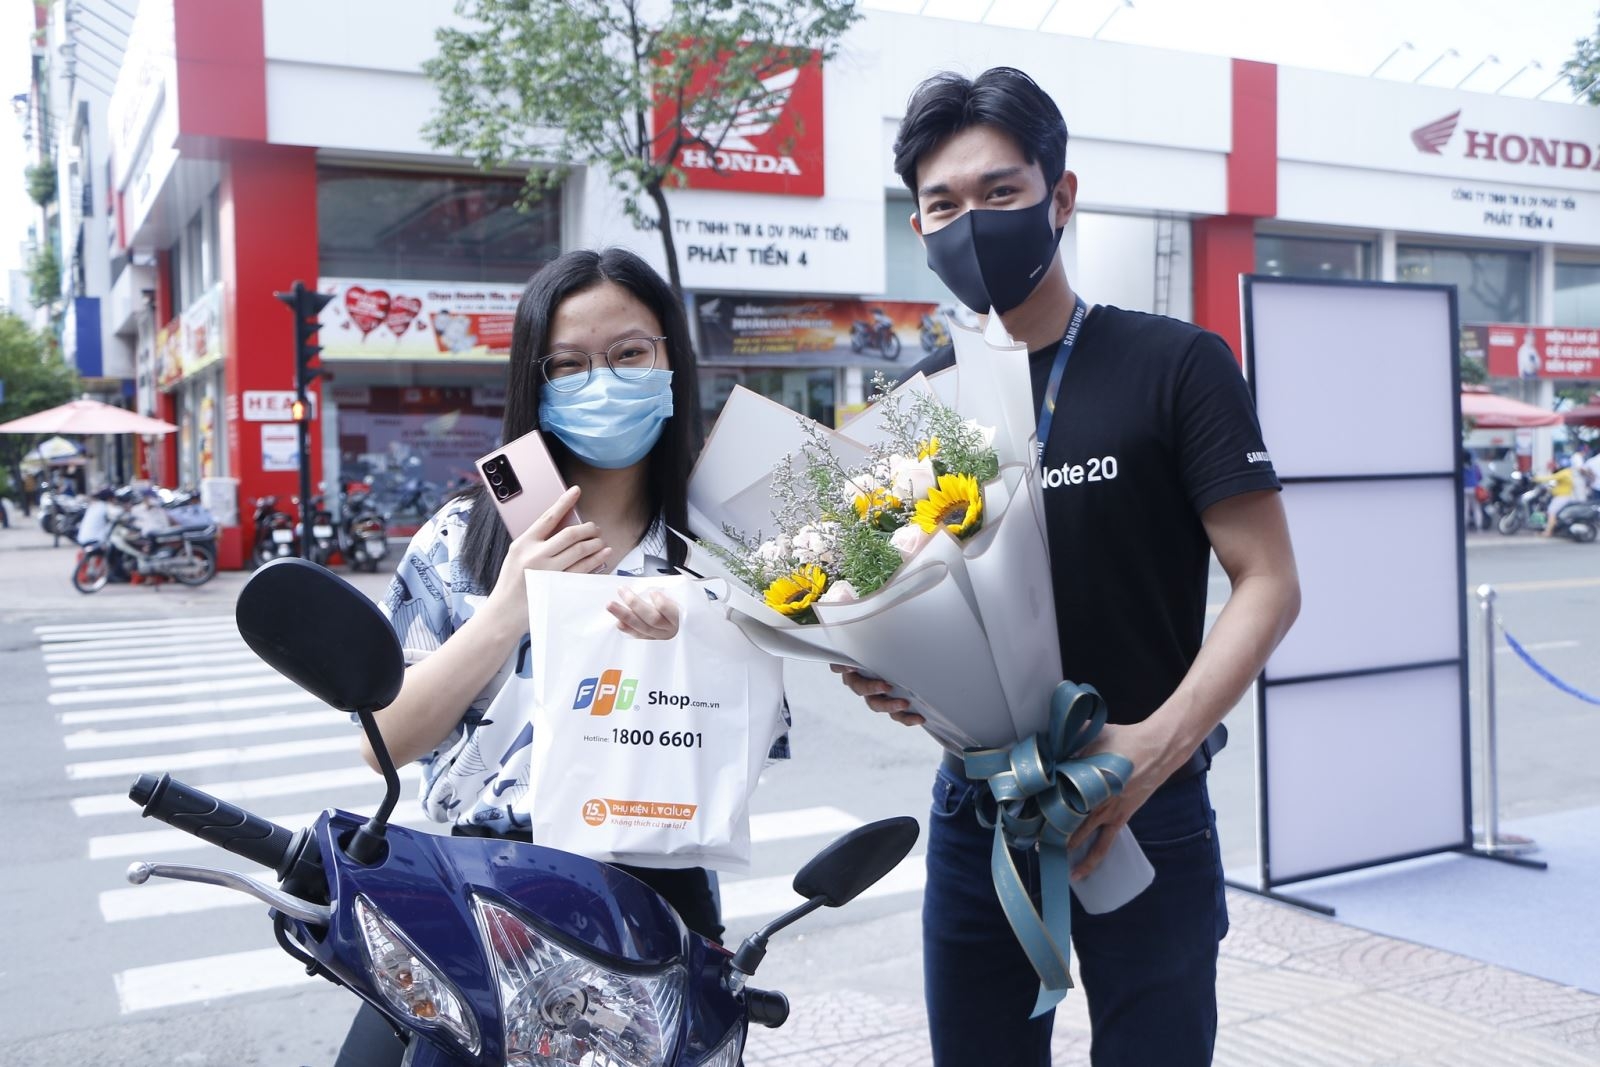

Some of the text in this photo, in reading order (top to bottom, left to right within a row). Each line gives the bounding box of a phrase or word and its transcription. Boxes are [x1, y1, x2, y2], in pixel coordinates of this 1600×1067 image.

[681, 149, 802, 176] HONDA
[675, 219, 690, 232] TY
[697, 219, 729, 236] TNHH
[734, 221, 751, 236] TM
[755, 224, 764, 238] &
[768, 225, 784, 239] DV
[788, 224, 819, 241] PHÁT
[824, 223, 849, 242] TIẾN
[1483, 209, 1554, 229] PHÁT TIẾN 4
[687, 243, 808, 268] PHÁT TIẾN 4
[1063, 306, 1085, 347] SAMSUNG
[1086, 456, 1118, 482] 20
[583, 728, 702, 748] Hotline: 1800 6601
[585, 803, 599, 816] 15
[613, 804, 628, 815] PHỤ
[629, 804, 649, 815] KIỆN
